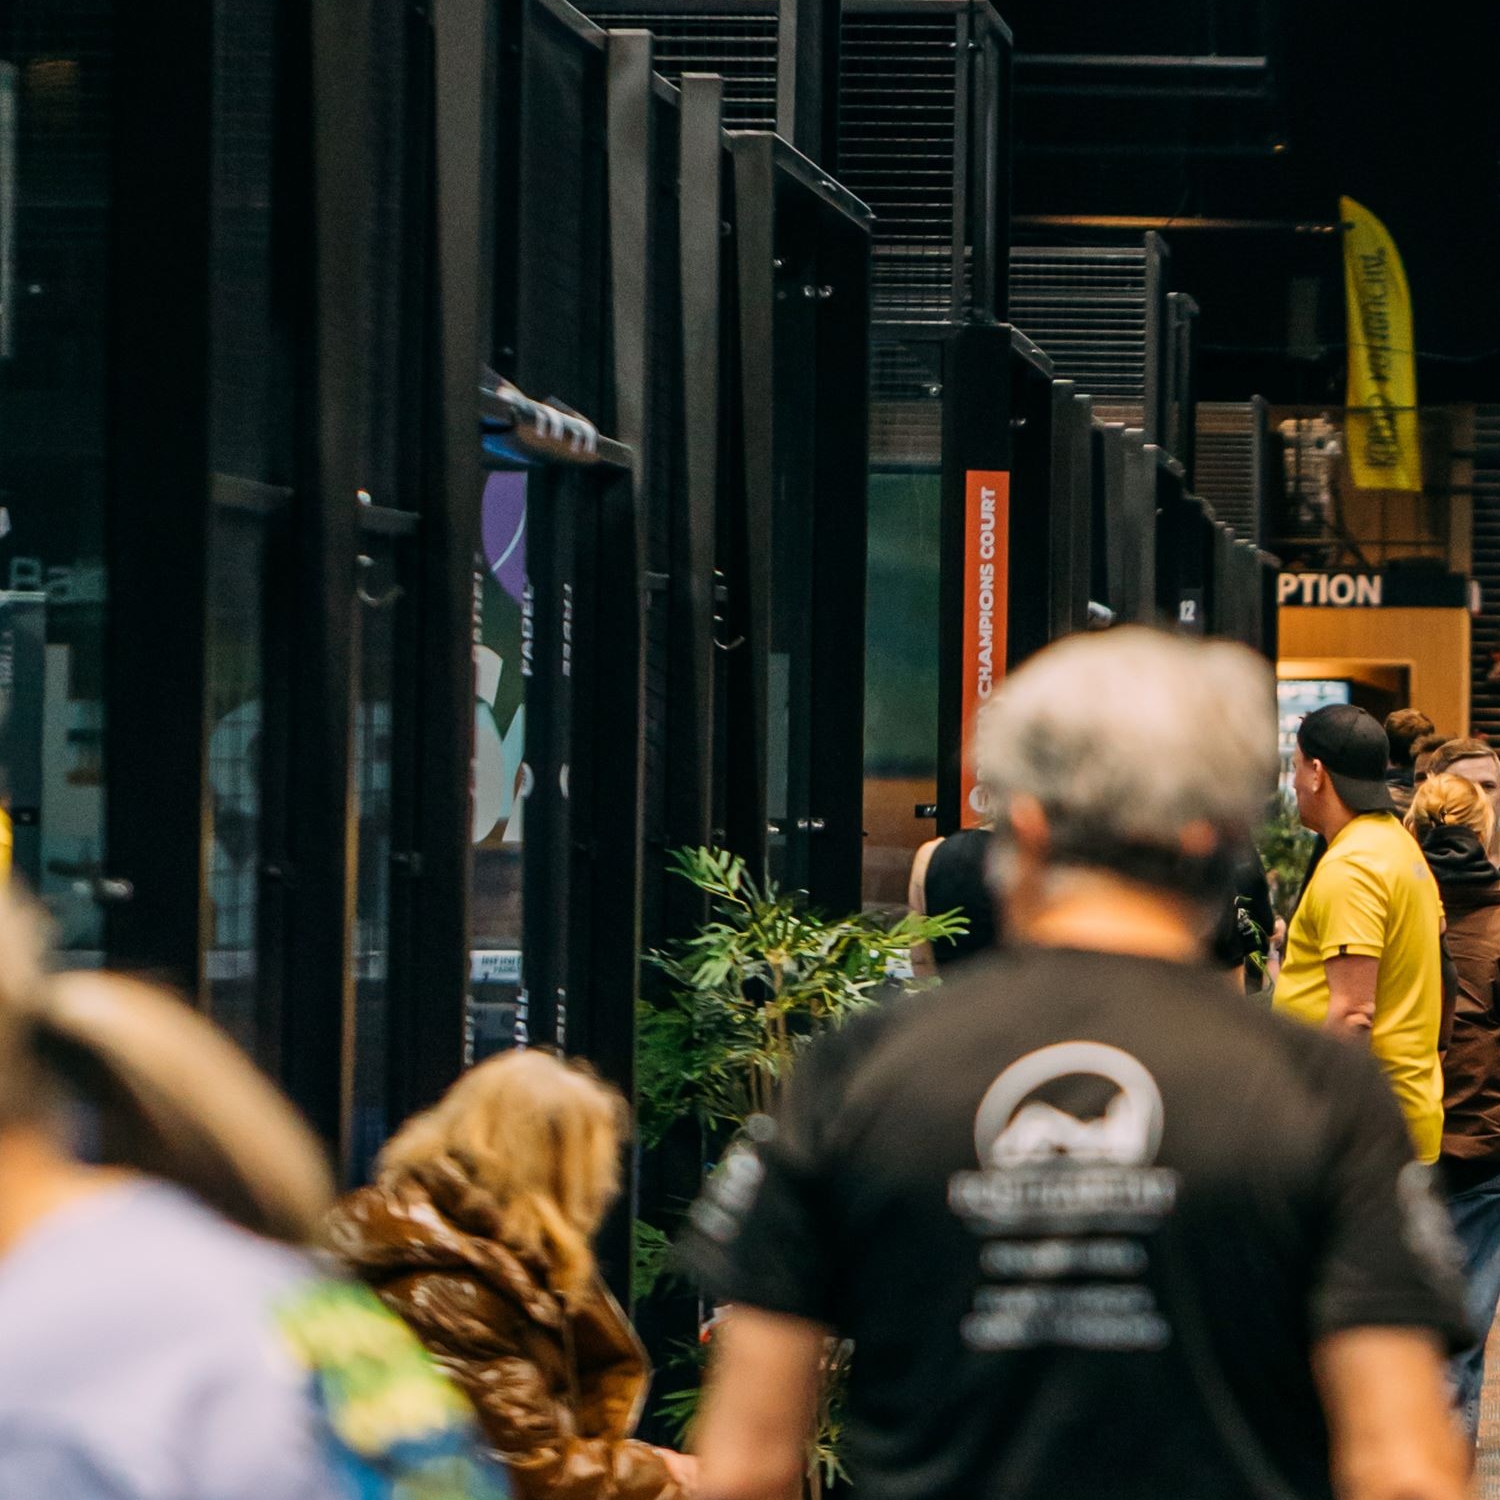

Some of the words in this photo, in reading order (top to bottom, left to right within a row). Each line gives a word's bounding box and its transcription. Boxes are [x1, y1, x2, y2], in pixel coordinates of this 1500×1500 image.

[979, 486, 996, 560] COURT
[1179, 599, 1196, 621] 12
[1277, 572, 1383, 606] PTION
[977, 563, 994, 700] CHAMPIONS
